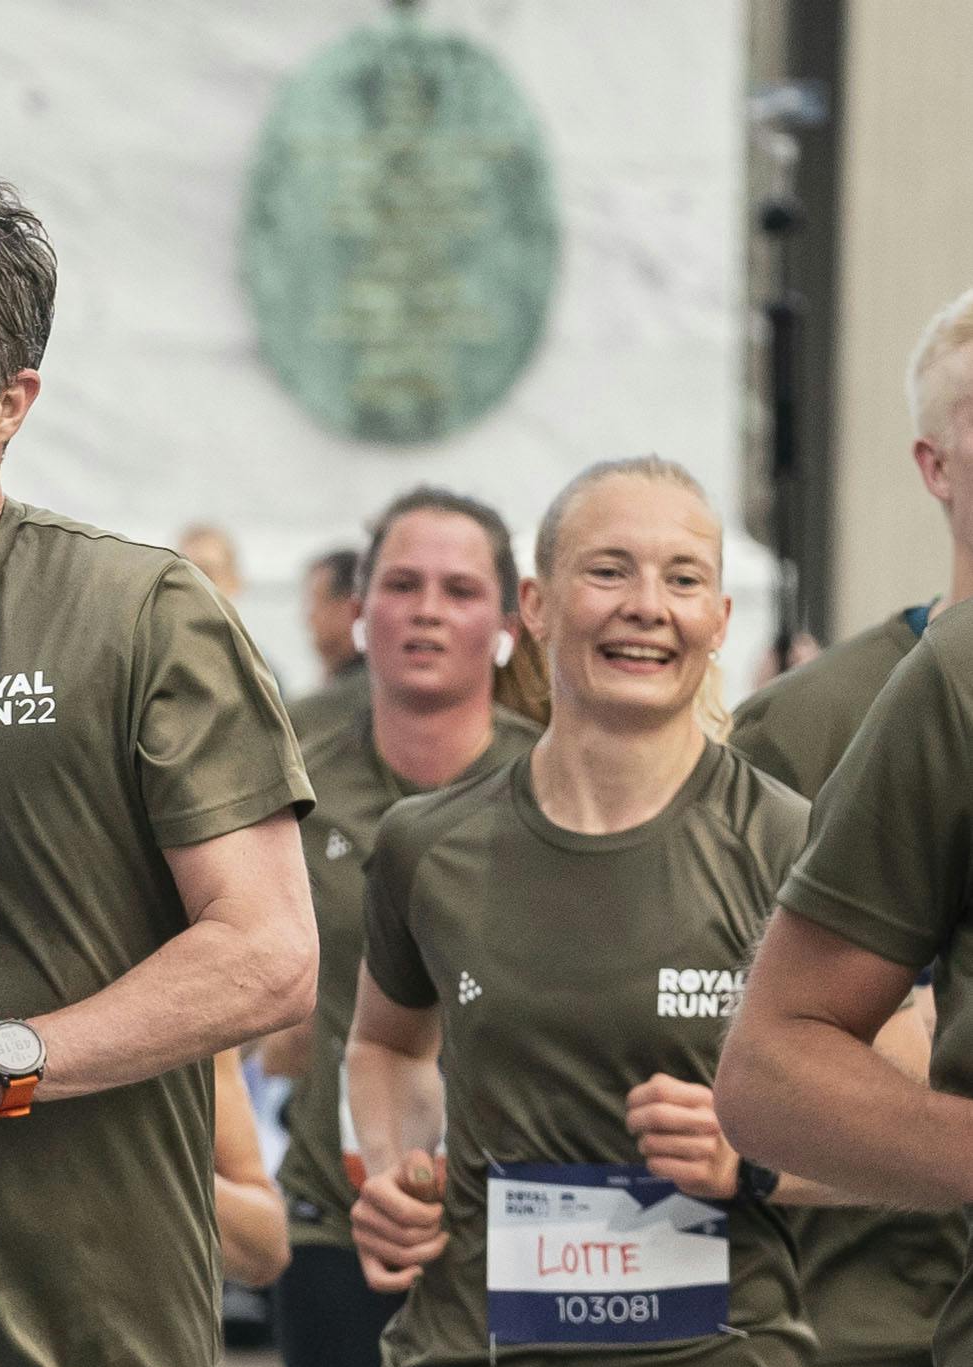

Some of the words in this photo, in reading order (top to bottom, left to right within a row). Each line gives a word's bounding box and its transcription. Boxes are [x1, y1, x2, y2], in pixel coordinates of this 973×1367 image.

[658, 967, 748, 993] ROYAL
[538, 1234, 641, 1277] LOTTE
[555, 1293, 660, 1325] 103081
